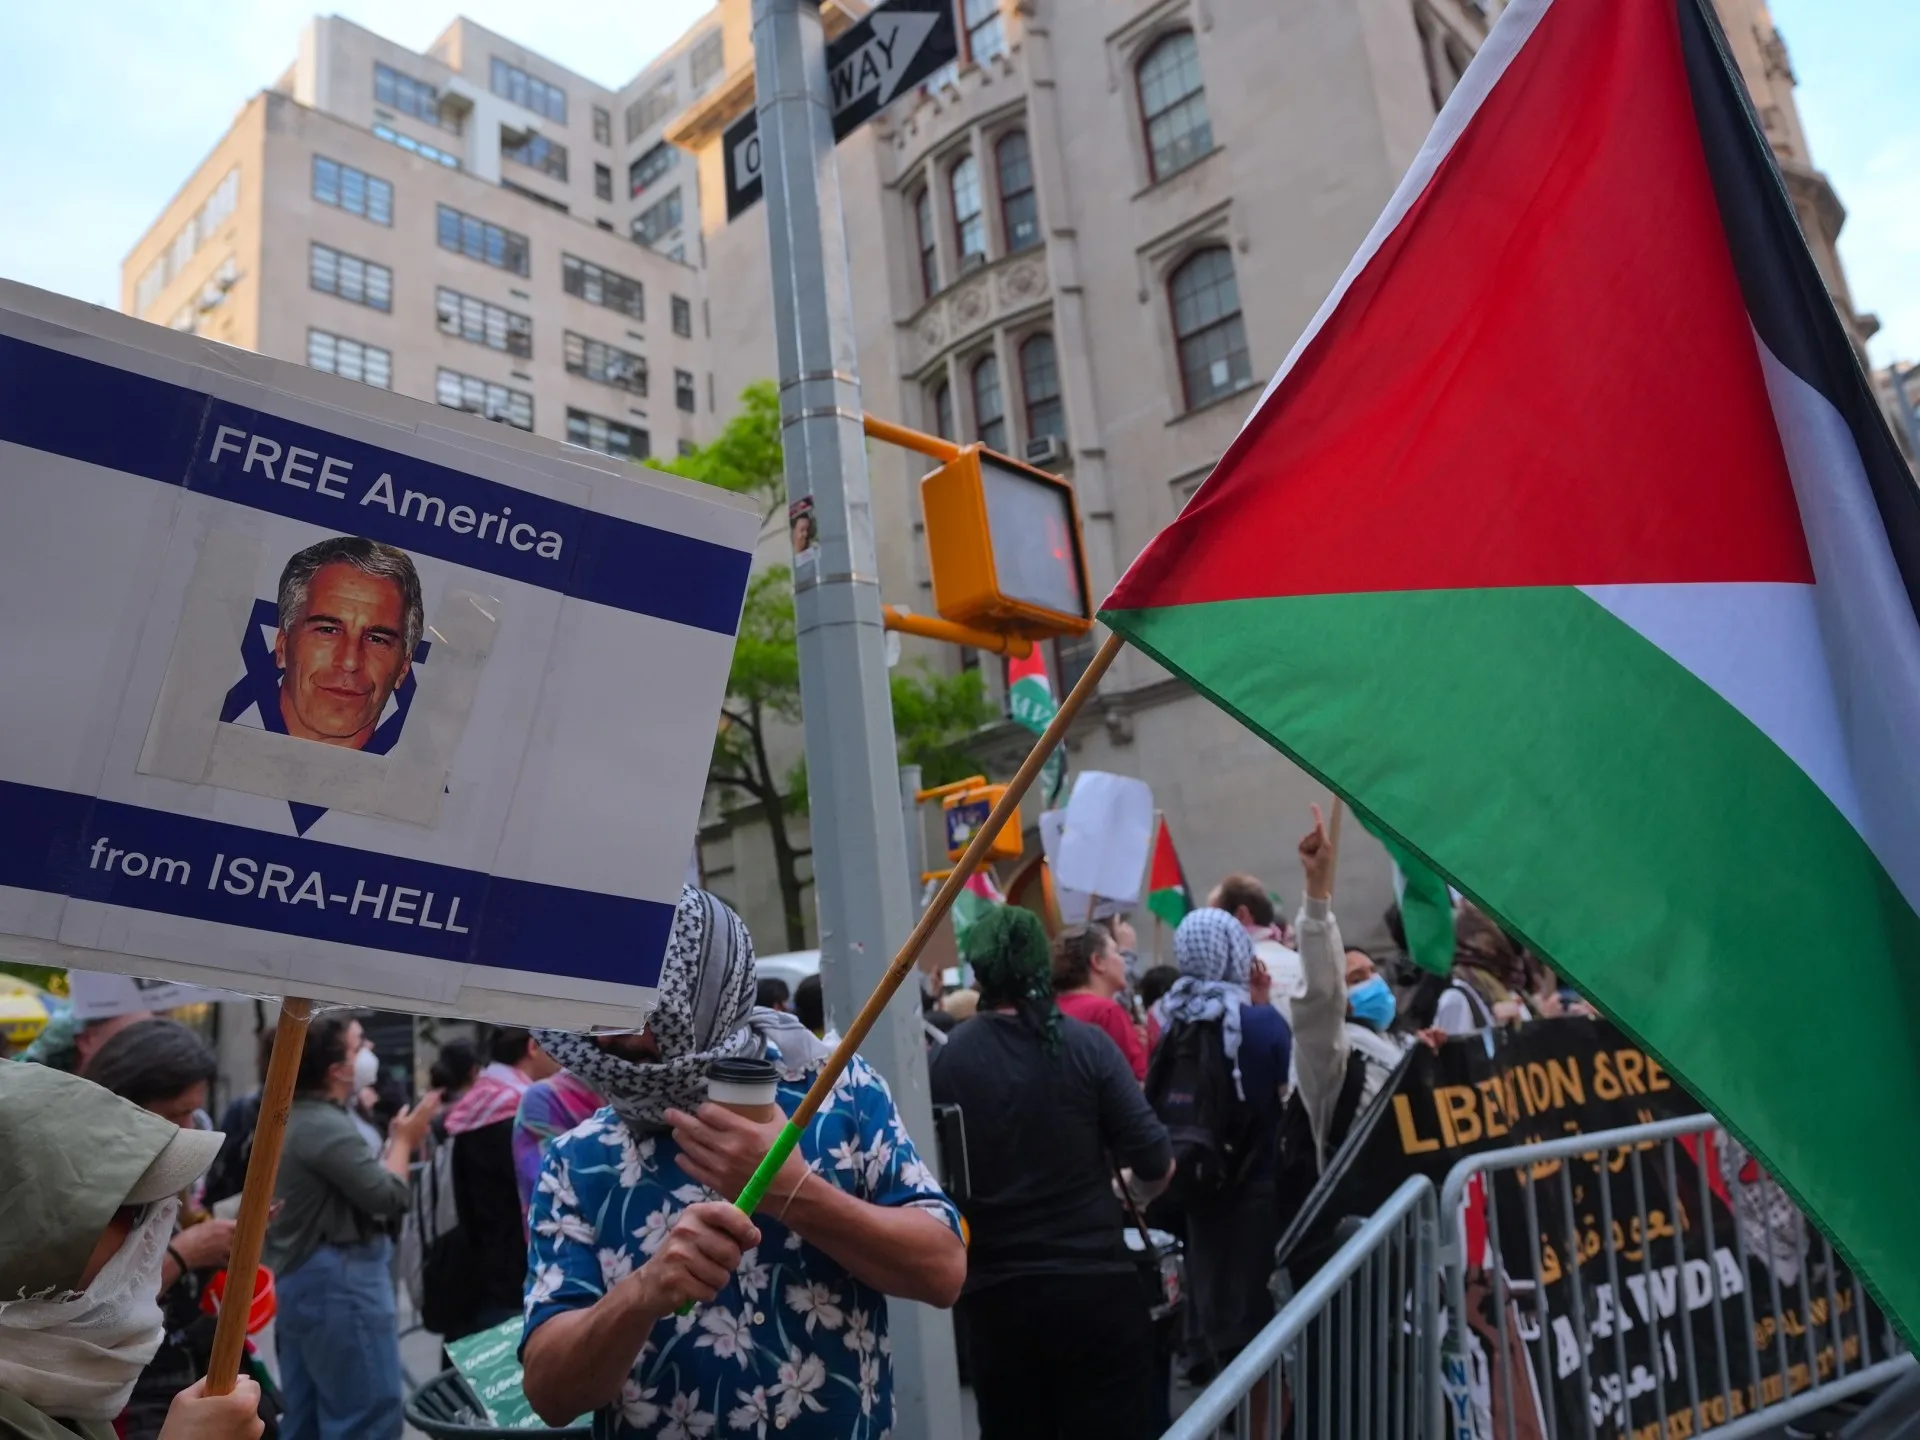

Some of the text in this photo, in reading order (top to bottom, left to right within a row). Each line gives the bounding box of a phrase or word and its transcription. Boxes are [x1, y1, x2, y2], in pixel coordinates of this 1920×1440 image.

[830, 26, 899, 107] WAY
[209, 425, 564, 561] FREE America
[89, 837, 469, 934] from ISRA-HELL
